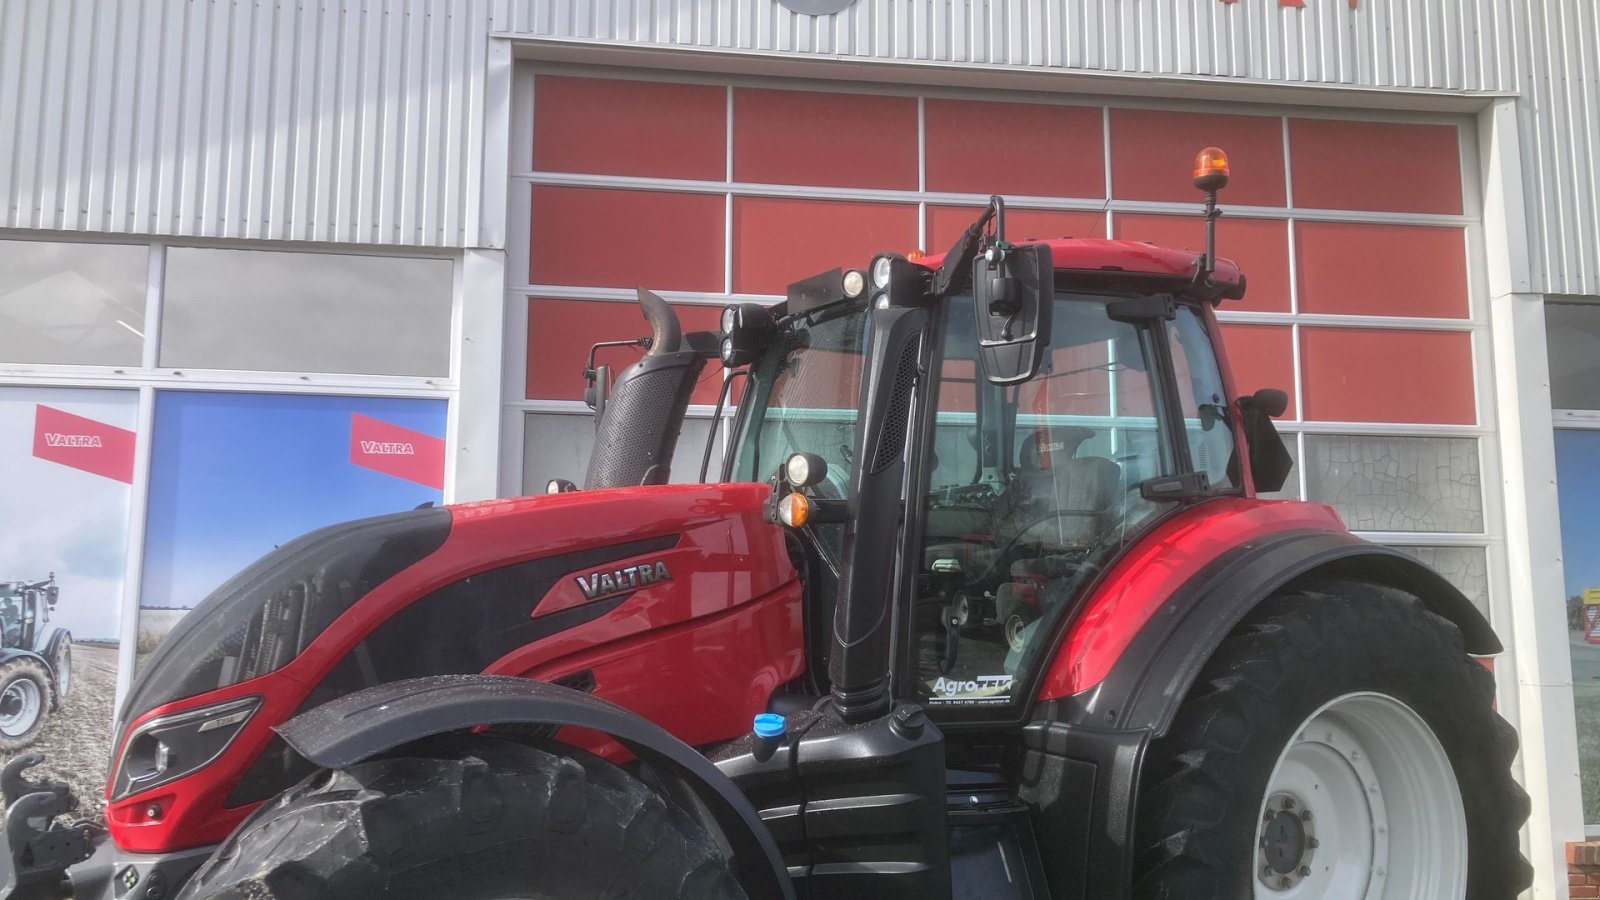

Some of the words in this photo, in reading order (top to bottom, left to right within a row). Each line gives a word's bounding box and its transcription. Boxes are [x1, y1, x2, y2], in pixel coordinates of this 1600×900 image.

[45, 433, 102, 447] VALTRA
[361, 441, 414, 455] VALTRA
[575, 560, 673, 600] VALTRA
